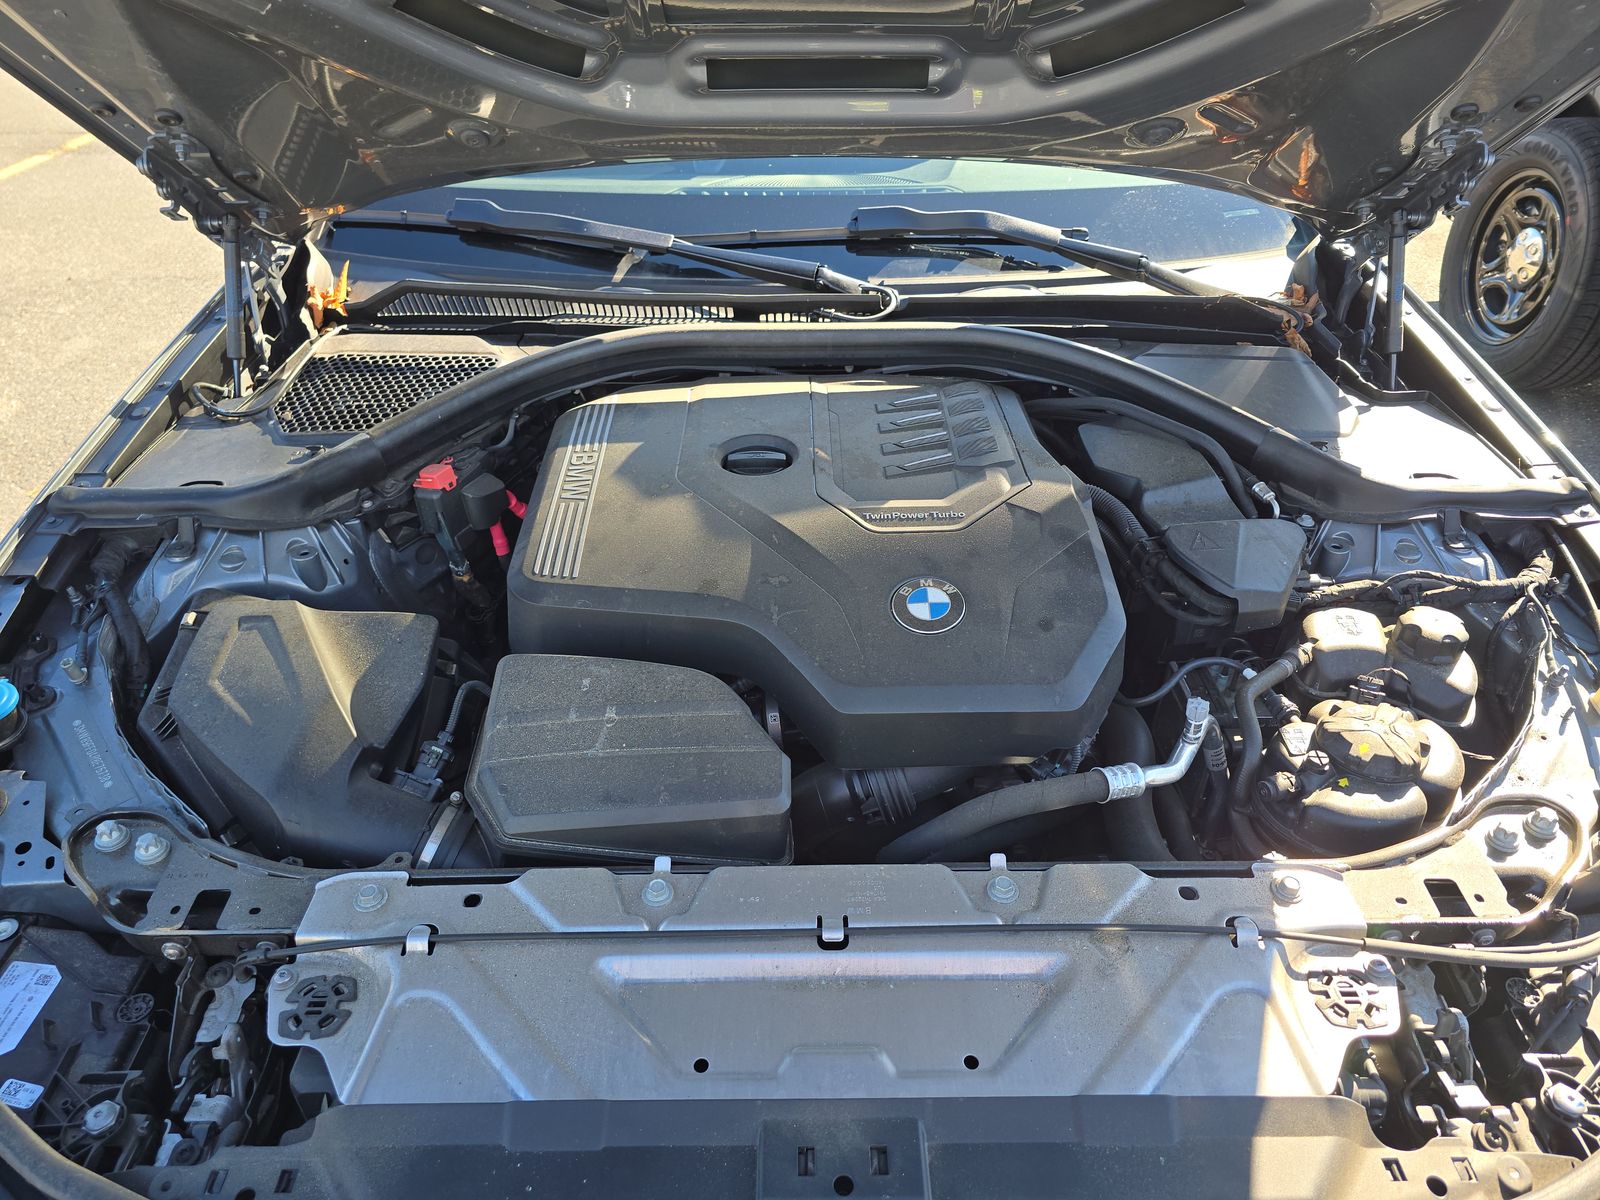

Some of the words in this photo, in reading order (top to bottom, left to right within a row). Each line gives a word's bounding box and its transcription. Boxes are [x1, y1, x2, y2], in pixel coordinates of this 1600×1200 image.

[560, 451, 599, 501] BMW
[863, 511, 929, 520] TwinPower
[930, 510, 966, 519] Turbo
[899, 578, 957, 596] BMW
